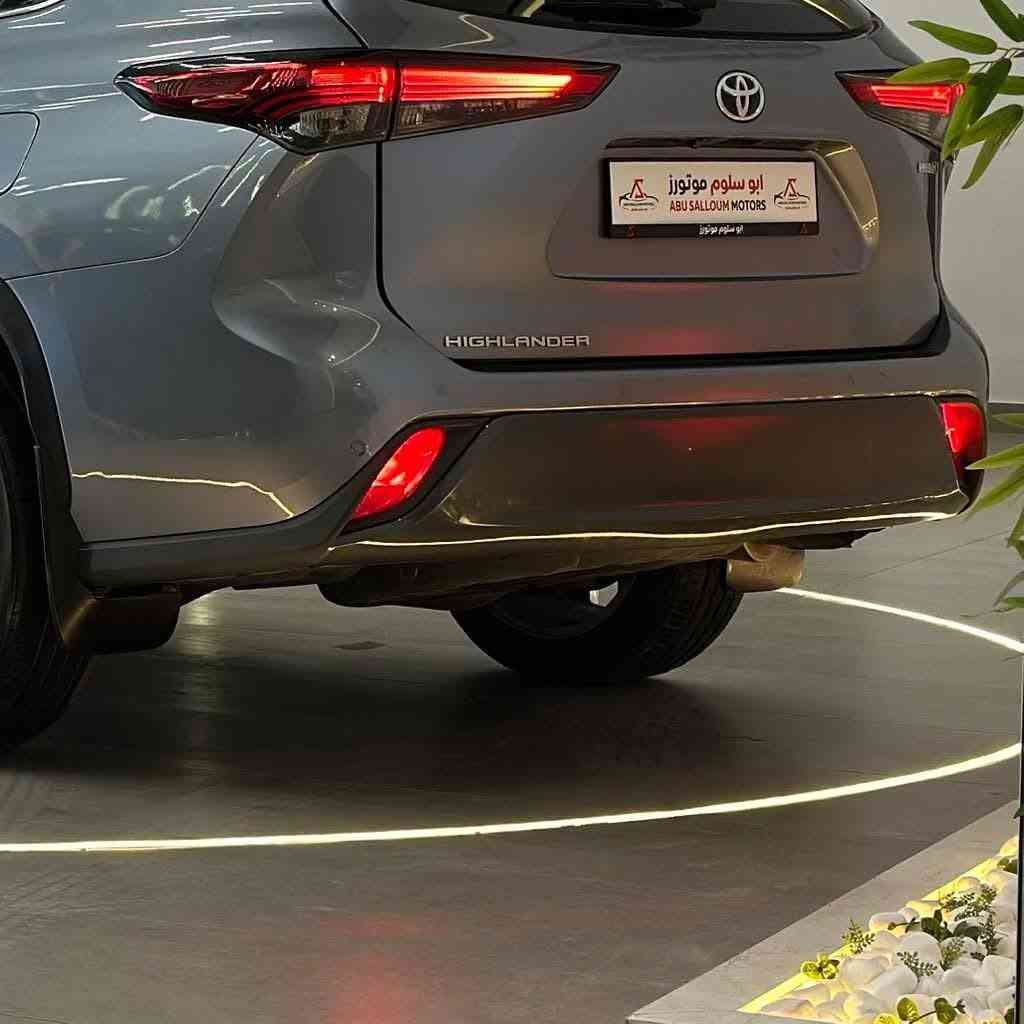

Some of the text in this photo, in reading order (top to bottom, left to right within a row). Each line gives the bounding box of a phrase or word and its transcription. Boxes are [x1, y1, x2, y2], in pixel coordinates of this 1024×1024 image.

[668, 174, 764, 196] ابو سلوم موتورز
[670, 200, 688, 212] ABU
[689, 200, 730, 212] SALLOUM
[731, 200, 767, 212] MOTORS
[445, 335, 591, 348] HIGHLANDER
